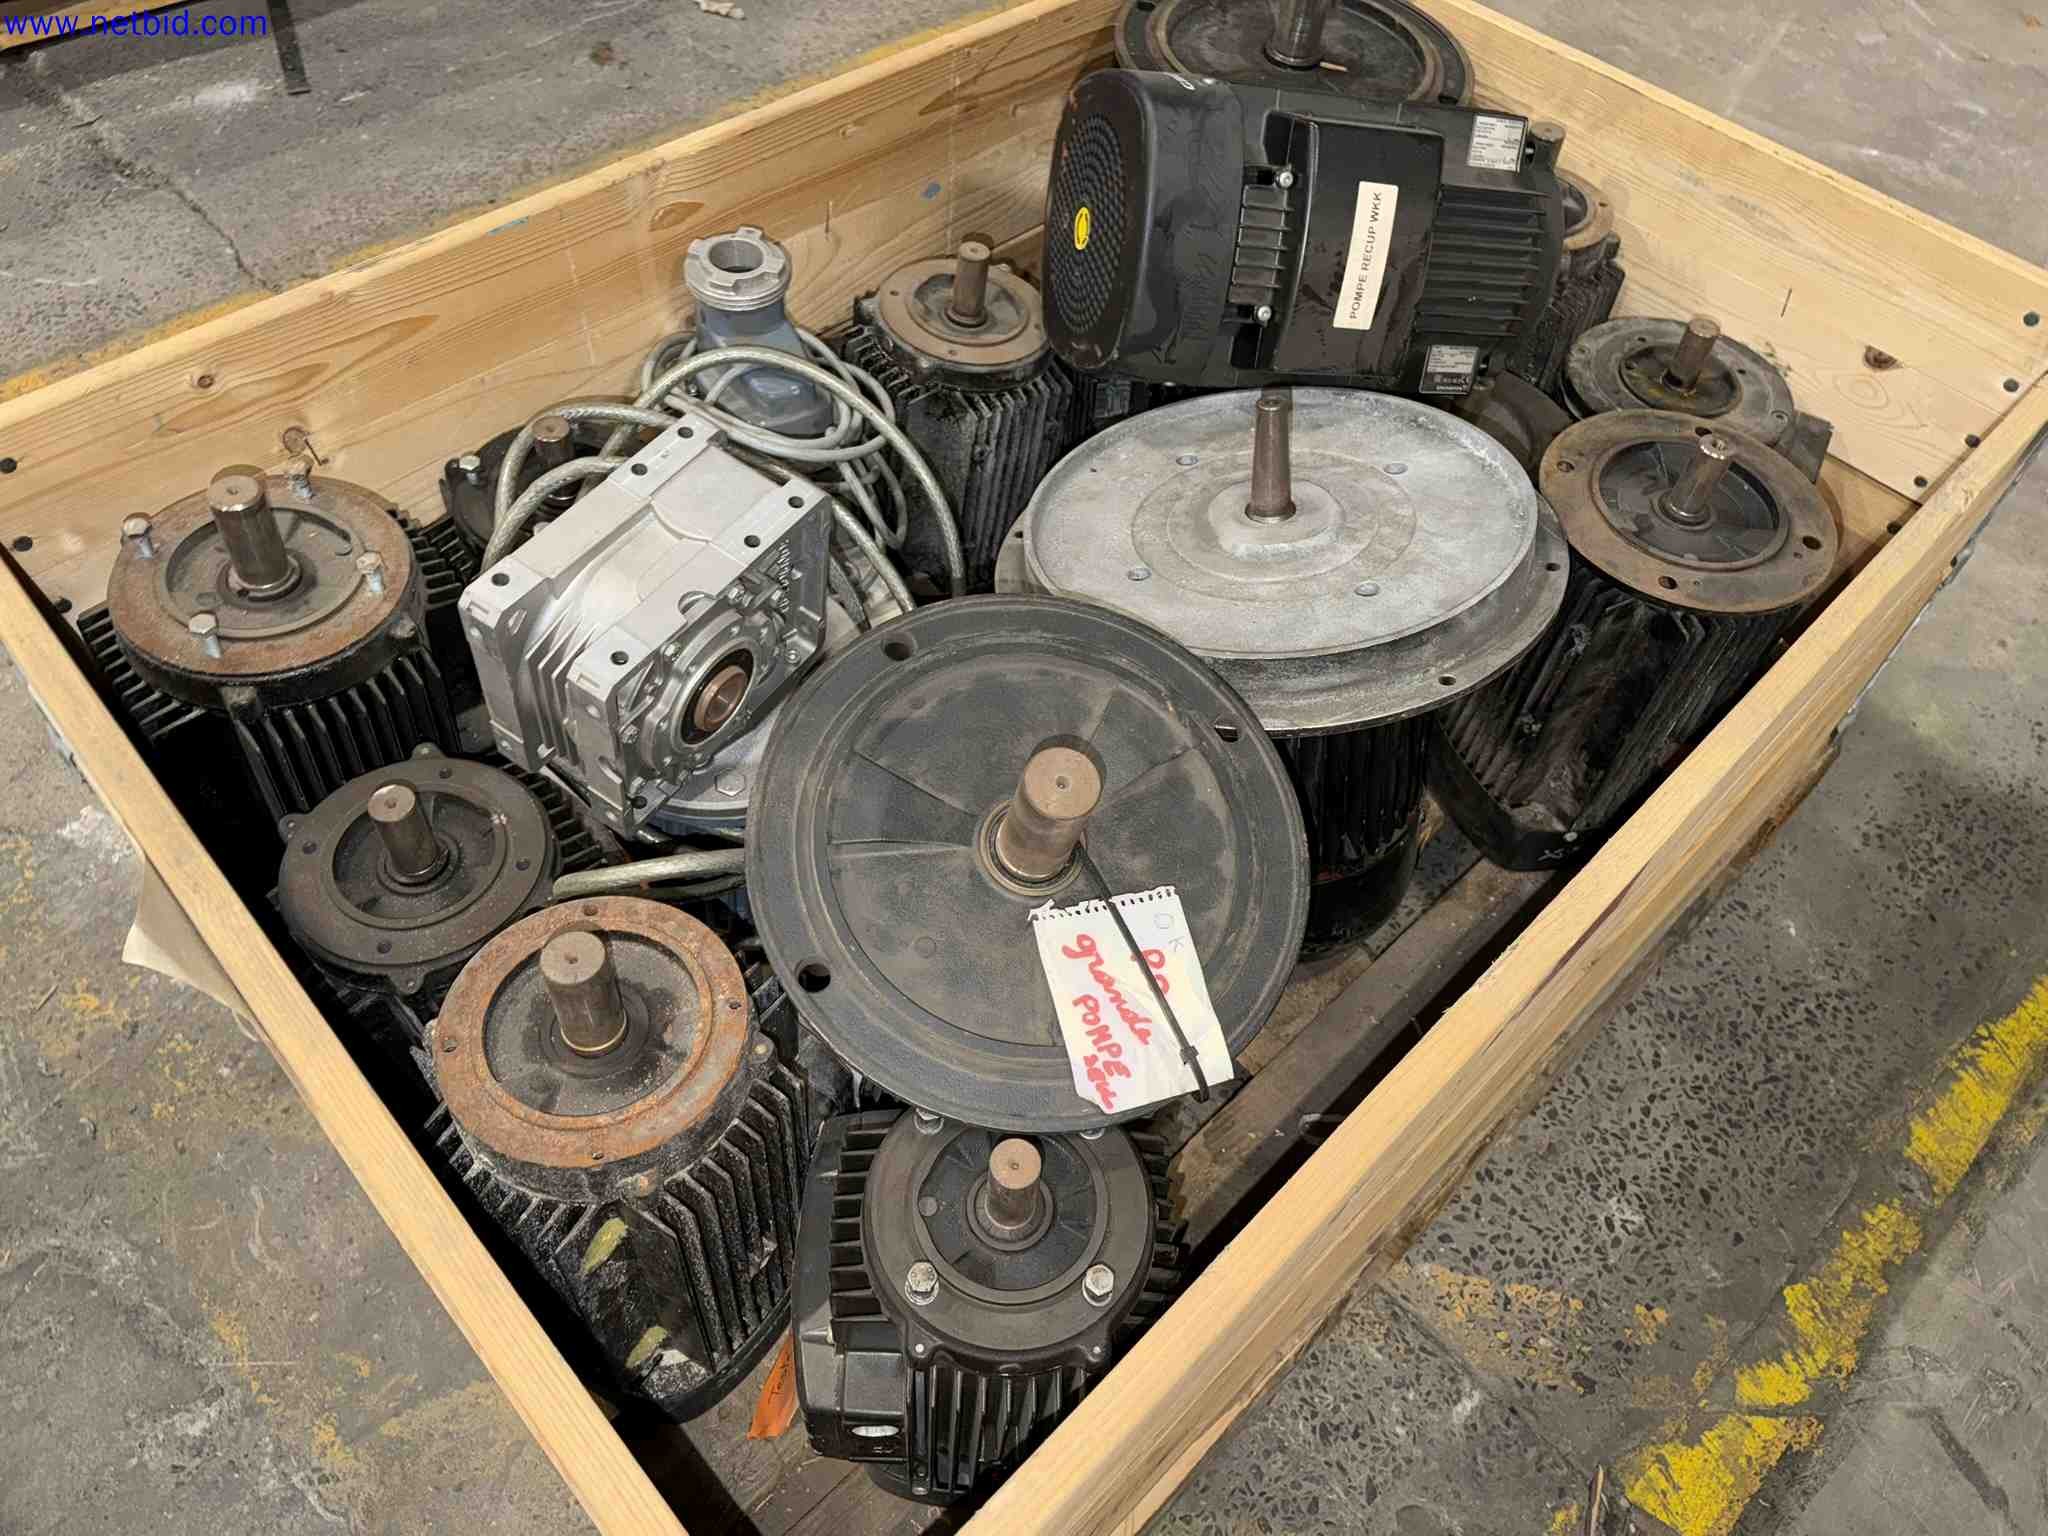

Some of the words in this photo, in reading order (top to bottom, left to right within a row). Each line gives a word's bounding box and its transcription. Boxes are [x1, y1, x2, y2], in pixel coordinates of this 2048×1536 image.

[1369, 192, 1382, 223] WKK
[1361, 226, 1378, 271] RECUP
[1349, 274, 1368, 319] POMPE
[1061, 933, 1152, 1046] grande
[1072, 994, 1132, 1078] POMPE
